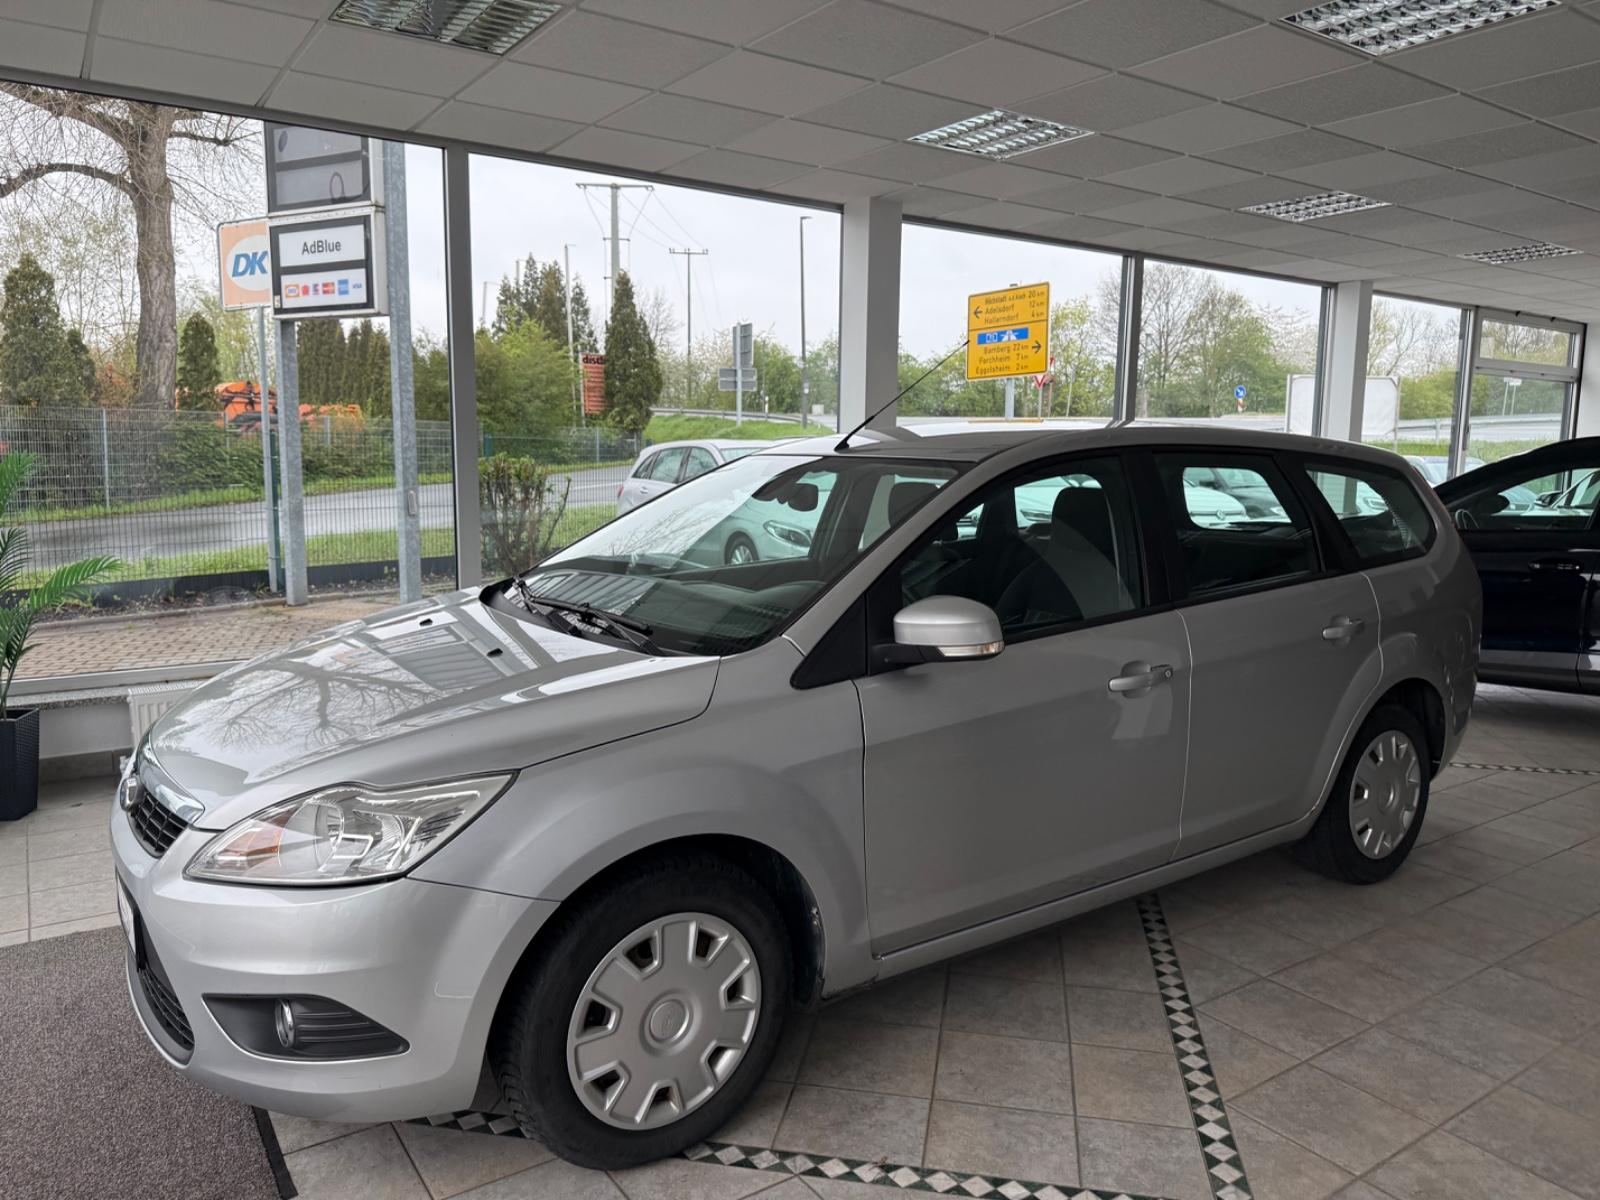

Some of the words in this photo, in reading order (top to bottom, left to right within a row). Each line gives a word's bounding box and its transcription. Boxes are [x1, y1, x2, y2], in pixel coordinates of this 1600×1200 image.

[301, 239, 342, 255] AdBlue
[232, 250, 269, 278] DK
[1028, 290, 1036, 298] 20
[985, 304, 1015, 314] Adelsdorf
[1029, 300, 1036, 308] 12
[983, 345, 1010, 354] Bamberg
[1013, 343, 1020, 351] 22
[979, 355, 1010, 365] Forchheim
[975, 364, 1010, 375] Eggolsheim
